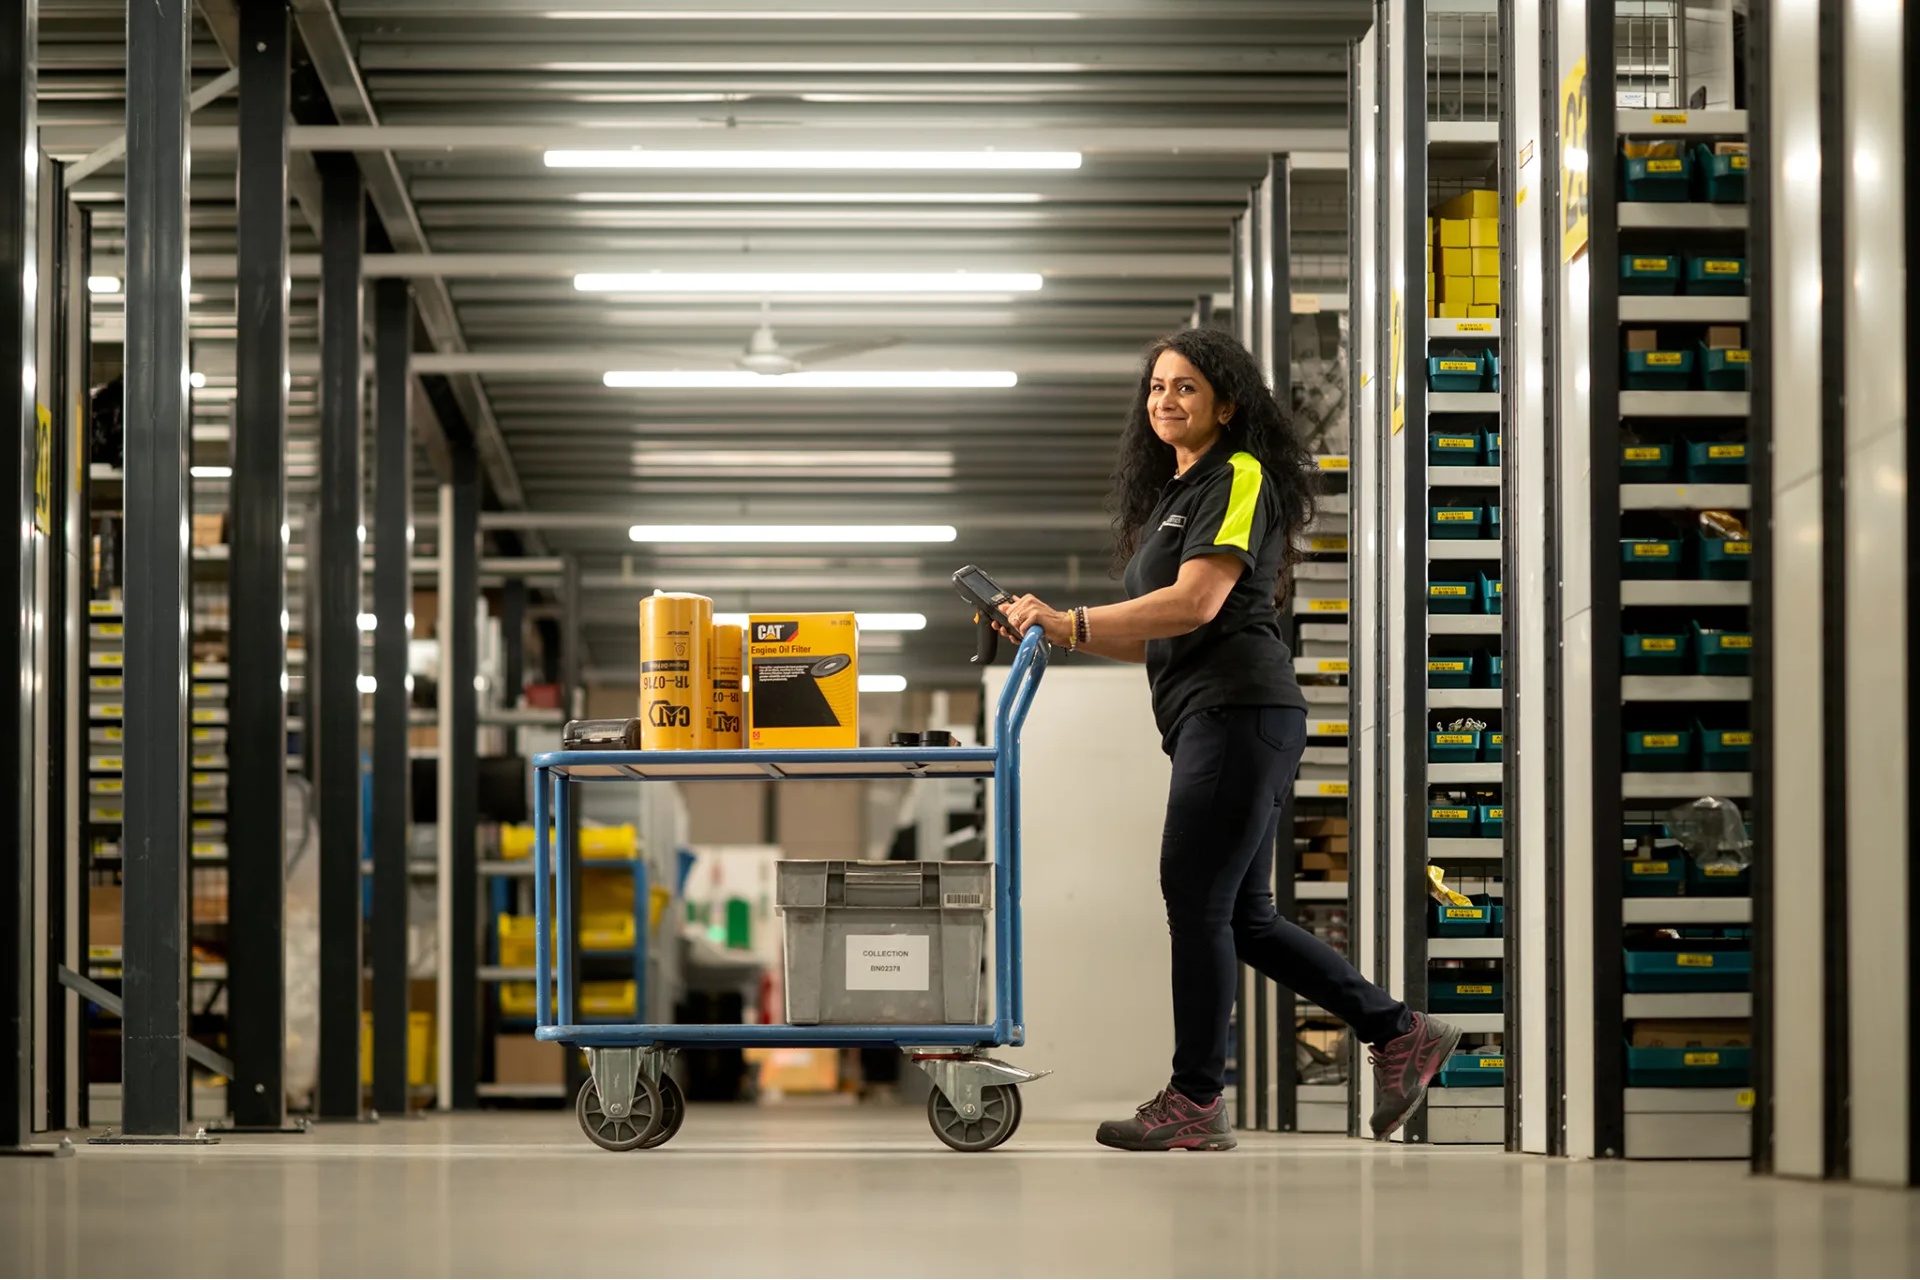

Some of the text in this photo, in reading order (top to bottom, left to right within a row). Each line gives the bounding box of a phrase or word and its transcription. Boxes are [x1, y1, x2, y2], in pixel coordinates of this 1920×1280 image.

[757, 624, 782, 640] CAT
[751, 644, 811, 655] Engine Oil Filter
[657, 705, 690, 727] CAT
[713, 716, 739, 732] CAT
